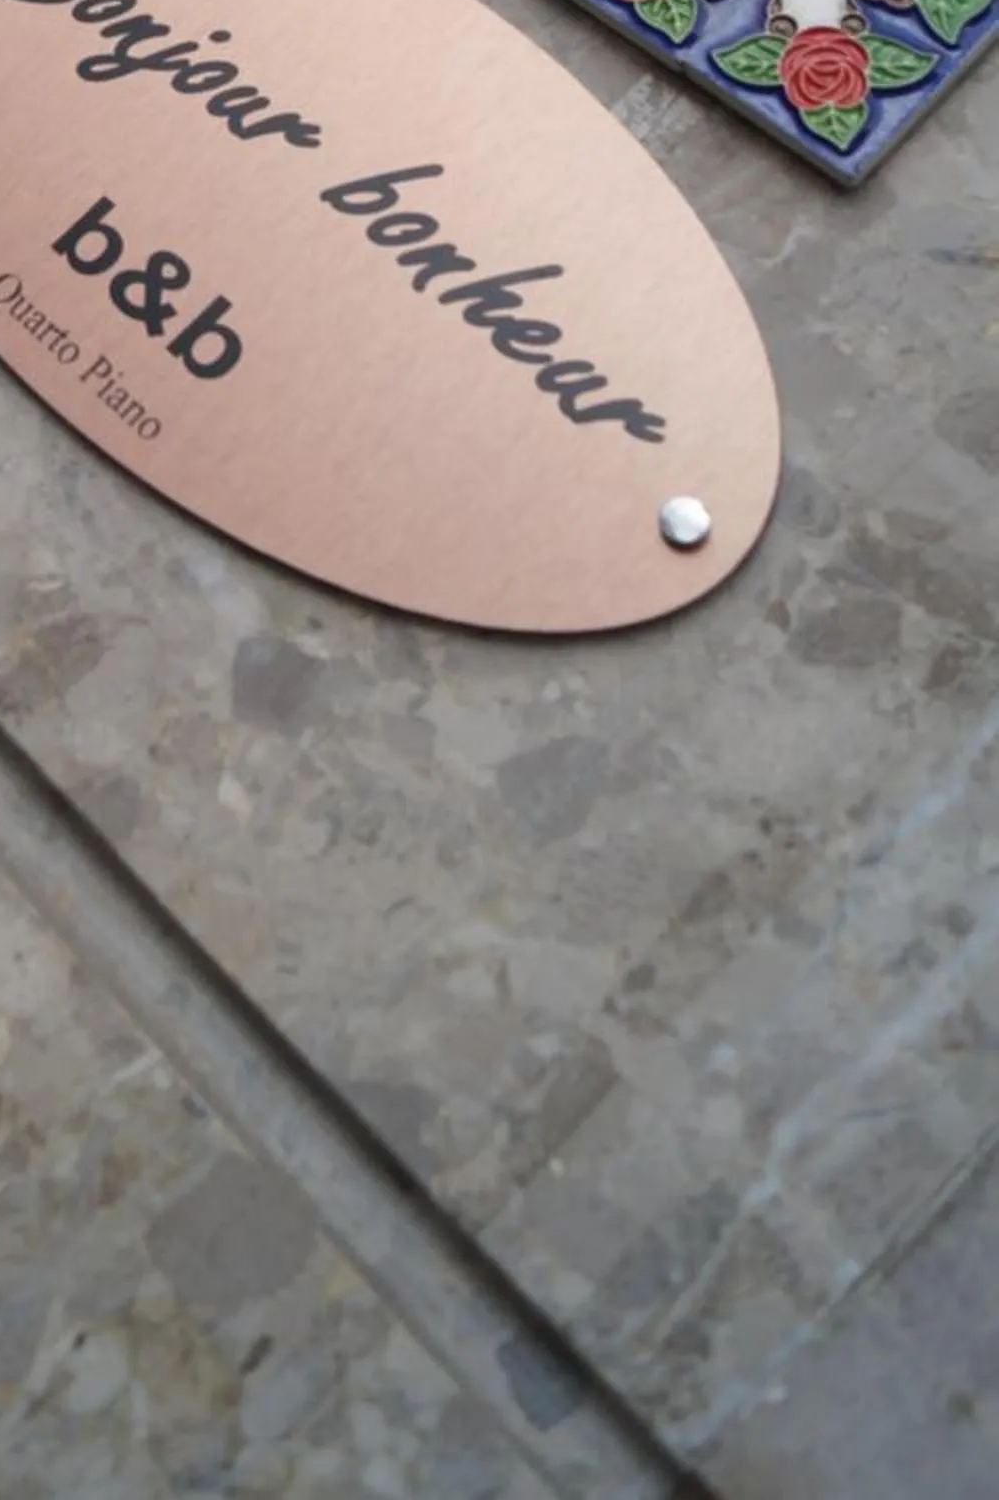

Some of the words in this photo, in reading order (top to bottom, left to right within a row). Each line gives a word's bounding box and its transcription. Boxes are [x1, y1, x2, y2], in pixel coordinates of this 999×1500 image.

[51, 196, 243, 380] b&b
[320, 164, 666, 443] bonheur
[79, 354, 162, 442] Piano
